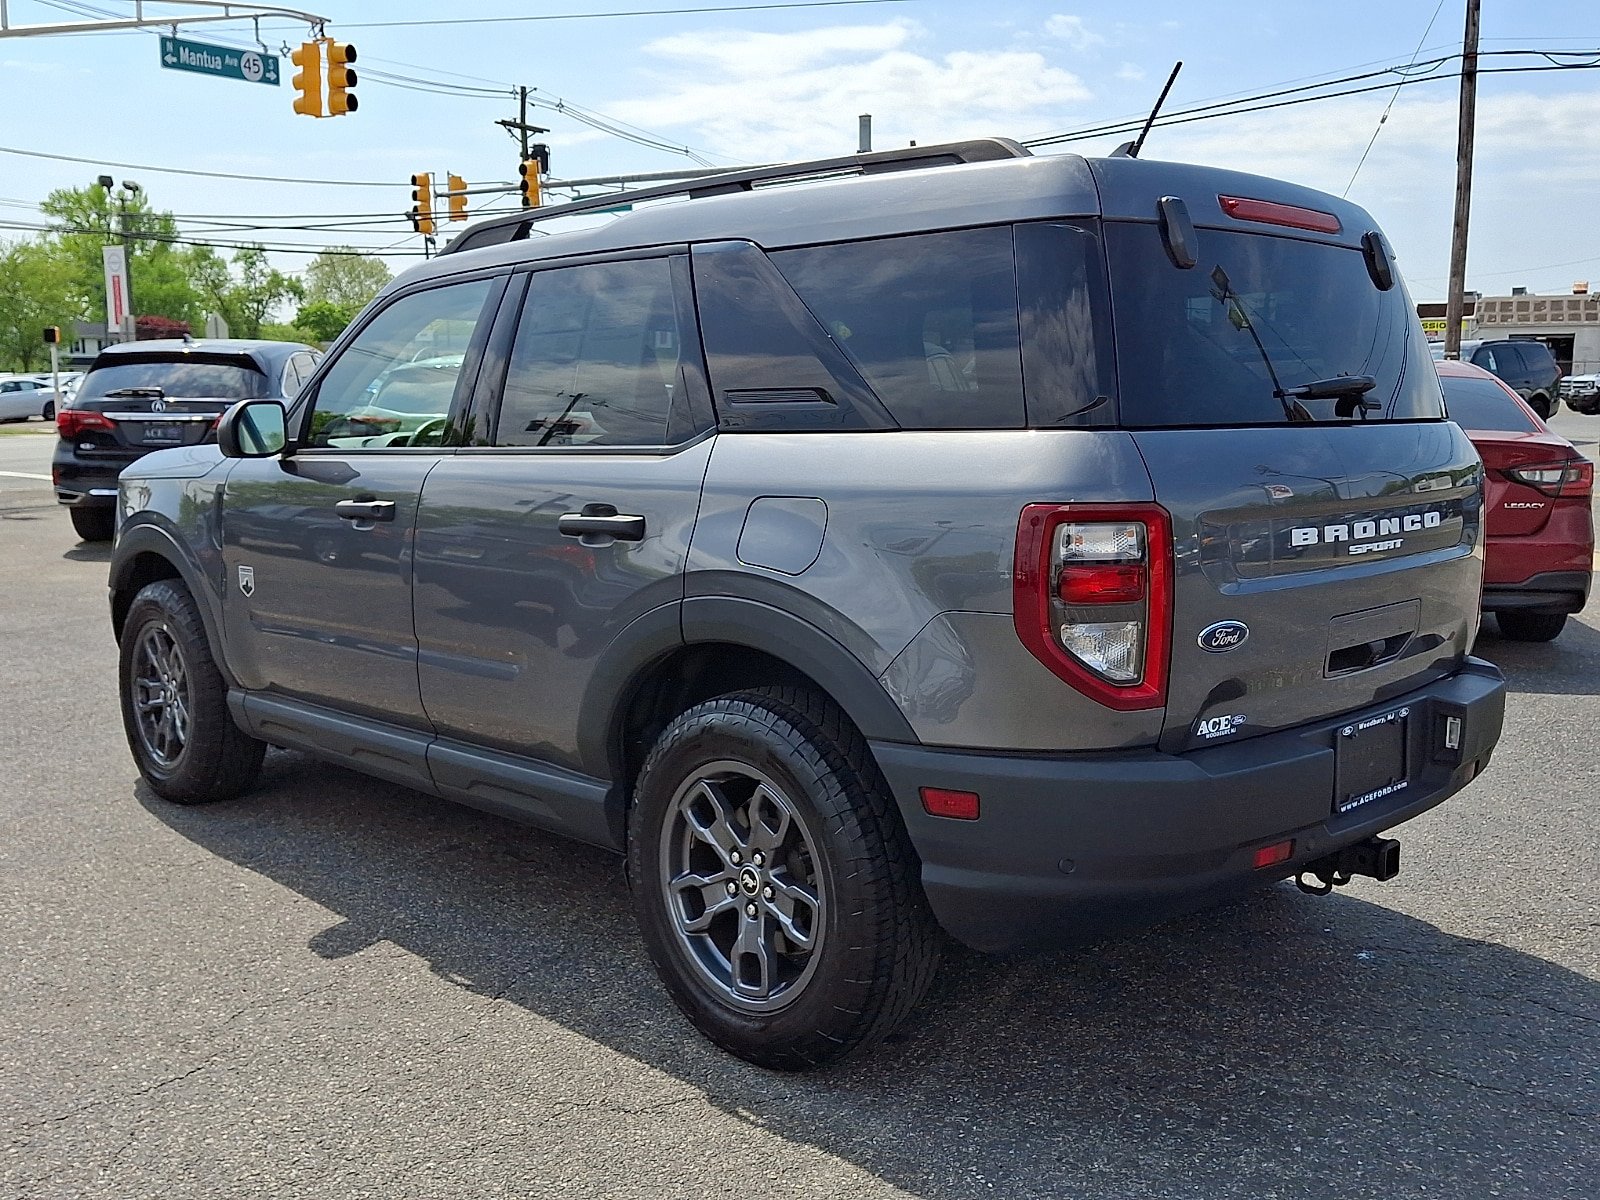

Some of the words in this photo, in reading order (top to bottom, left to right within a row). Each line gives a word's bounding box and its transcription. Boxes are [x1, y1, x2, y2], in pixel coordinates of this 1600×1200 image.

[166, 41, 173, 52] N
[179, 46, 222, 70] Mantua
[225, 54, 238, 67] Ave
[243, 57, 260, 74] 45
[268, 59, 274, 70] S
[1292, 511, 1440, 546] BRONCO
[1349, 538, 1404, 555] SPORT
[1212, 628, 1240, 646] Ford
[1197, 714, 1231, 736] ACE
[1387, 712, 1395, 721] NJ
[1340, 781, 1408, 812] www.ACEFORD.com
